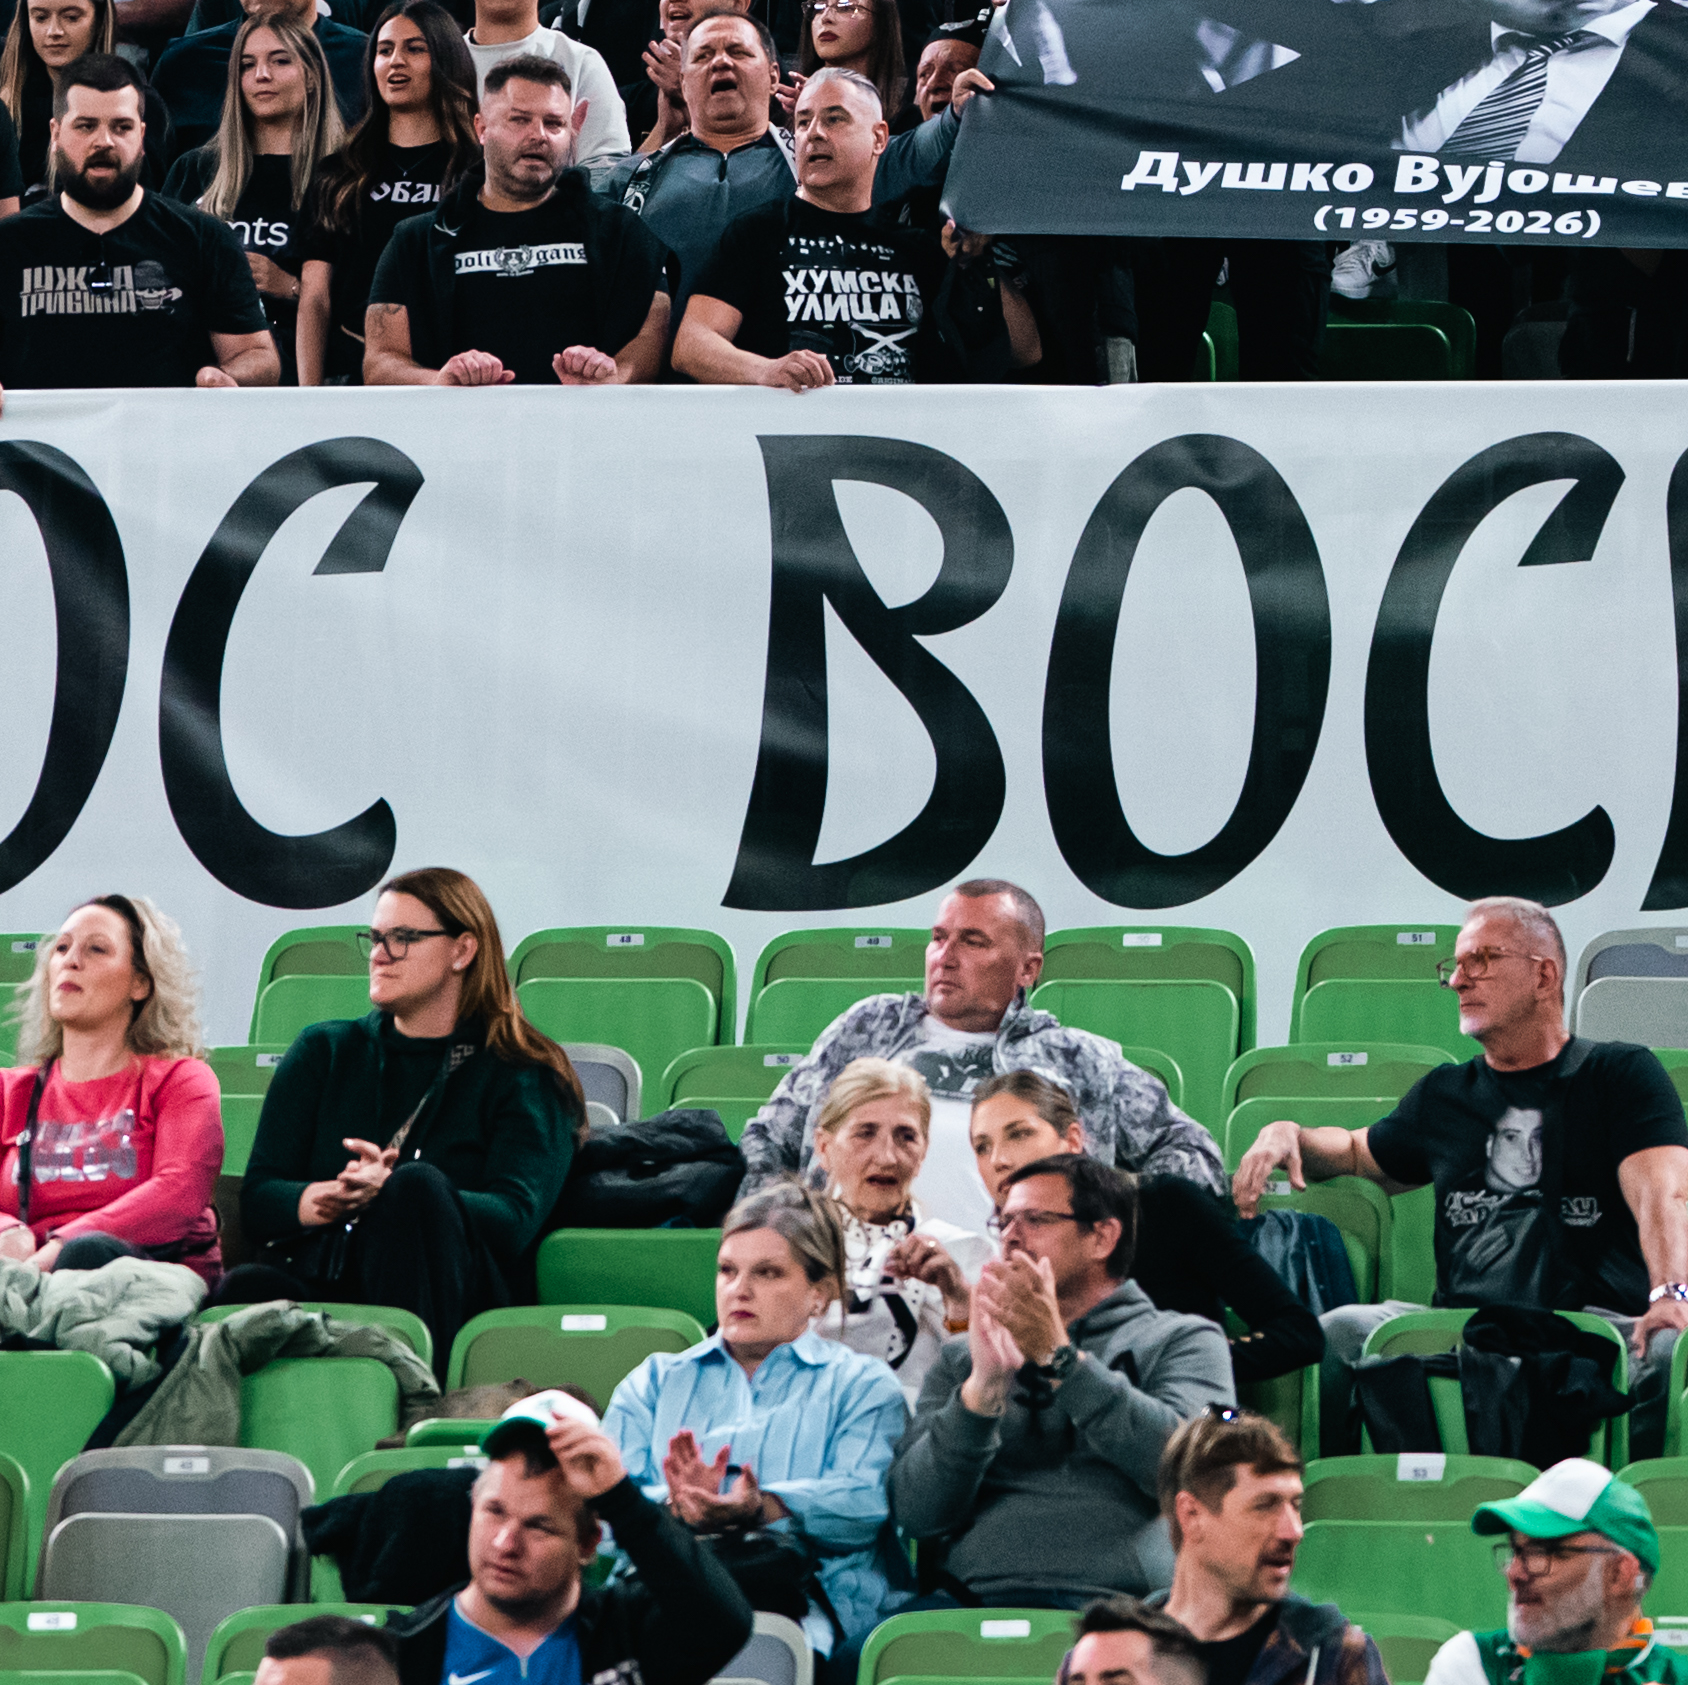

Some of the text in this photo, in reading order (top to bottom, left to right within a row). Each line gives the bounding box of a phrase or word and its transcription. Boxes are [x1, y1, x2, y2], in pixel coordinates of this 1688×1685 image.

[1120, 150, 1375, 196] Душко
[1313, 205, 1602, 239] (1959-2026)
[21, 265, 134, 292] ЈУЖА
[782, 269, 921, 297] ХУМСКА
[784, 293, 902, 323] УЛИЦА
